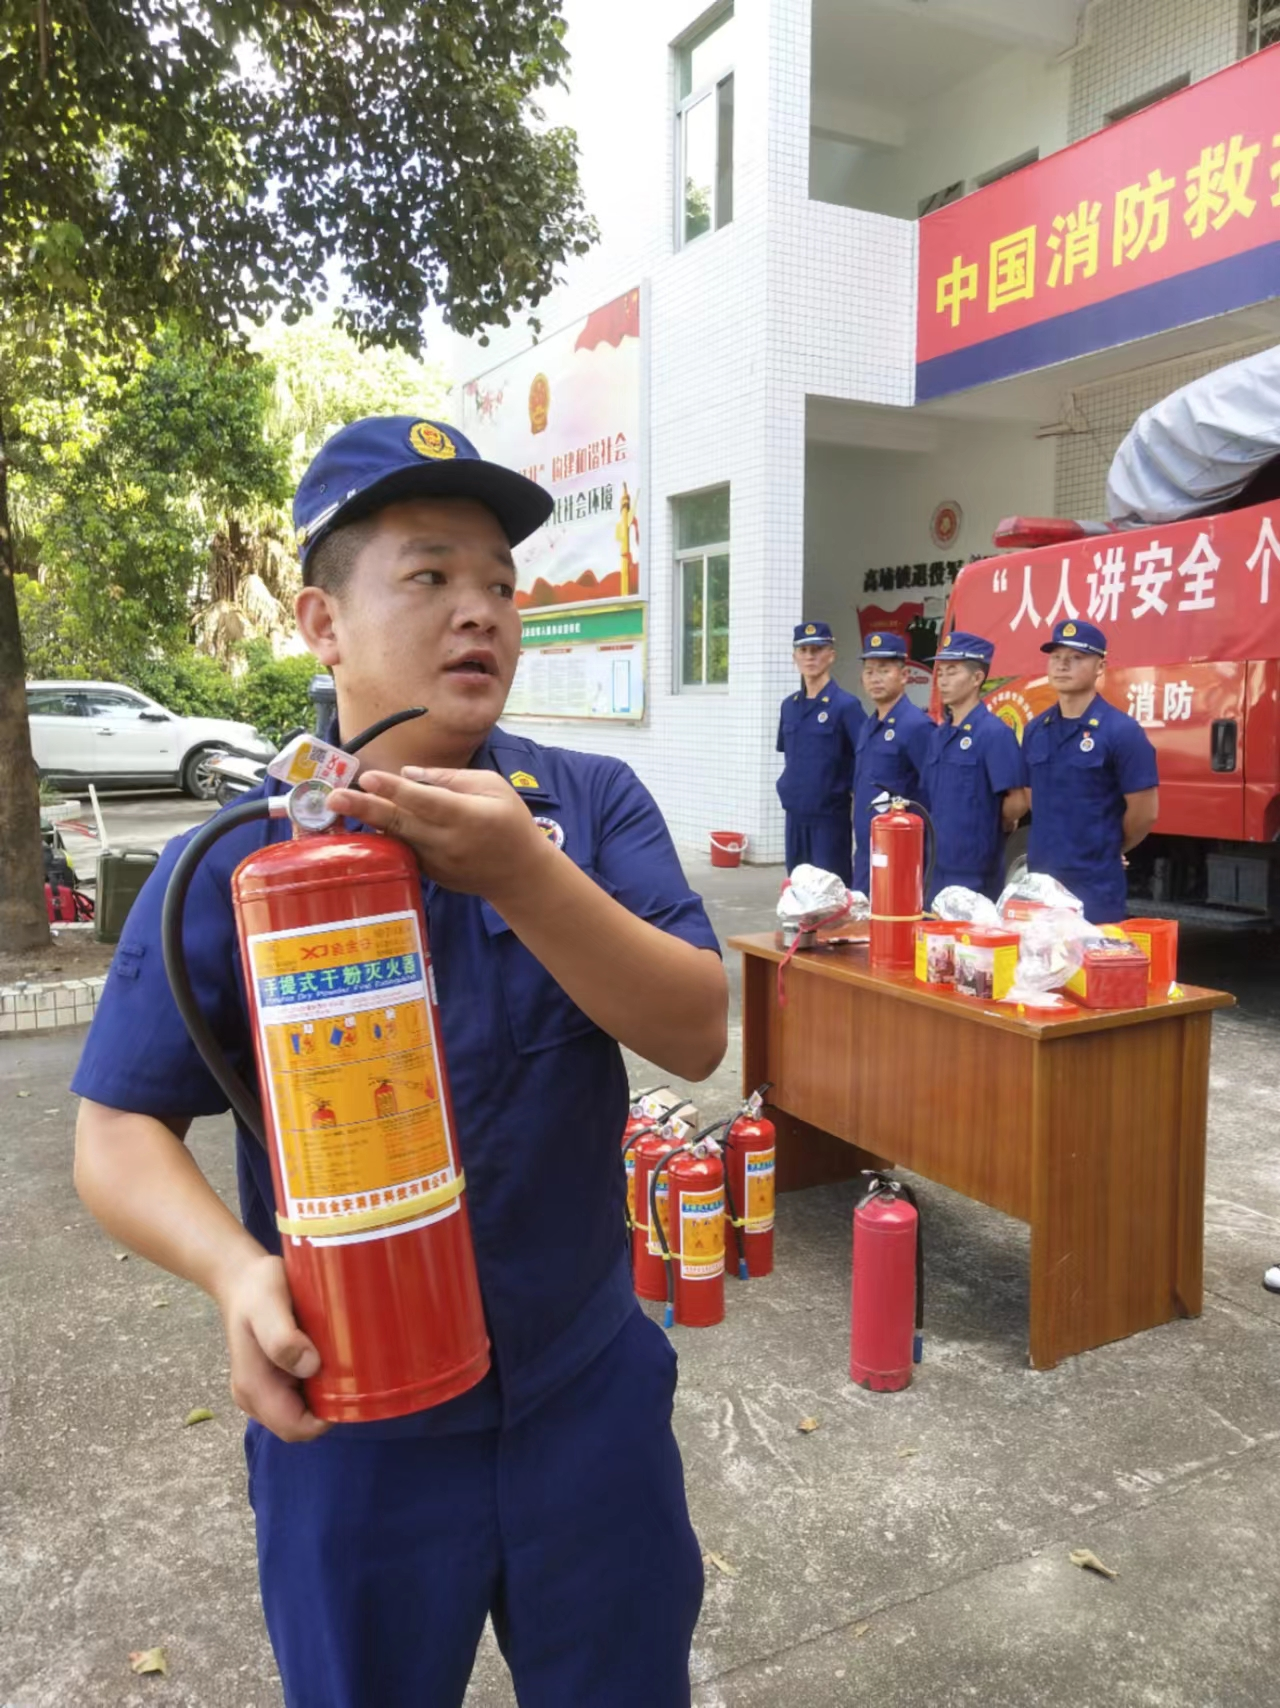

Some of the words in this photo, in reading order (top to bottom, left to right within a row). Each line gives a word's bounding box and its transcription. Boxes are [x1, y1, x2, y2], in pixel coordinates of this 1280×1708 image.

[935, 133, 1280, 328] 中国消防救
[552, 432, 627, 483] 构建和谐社会
[541, 483, 613, 527] 化社会环境
[992, 532, 1222, 632] “人人讲安全
[1126, 679, 1194, 721] 消防
[264, 954, 416, 998] 手提式干粉灭火器
